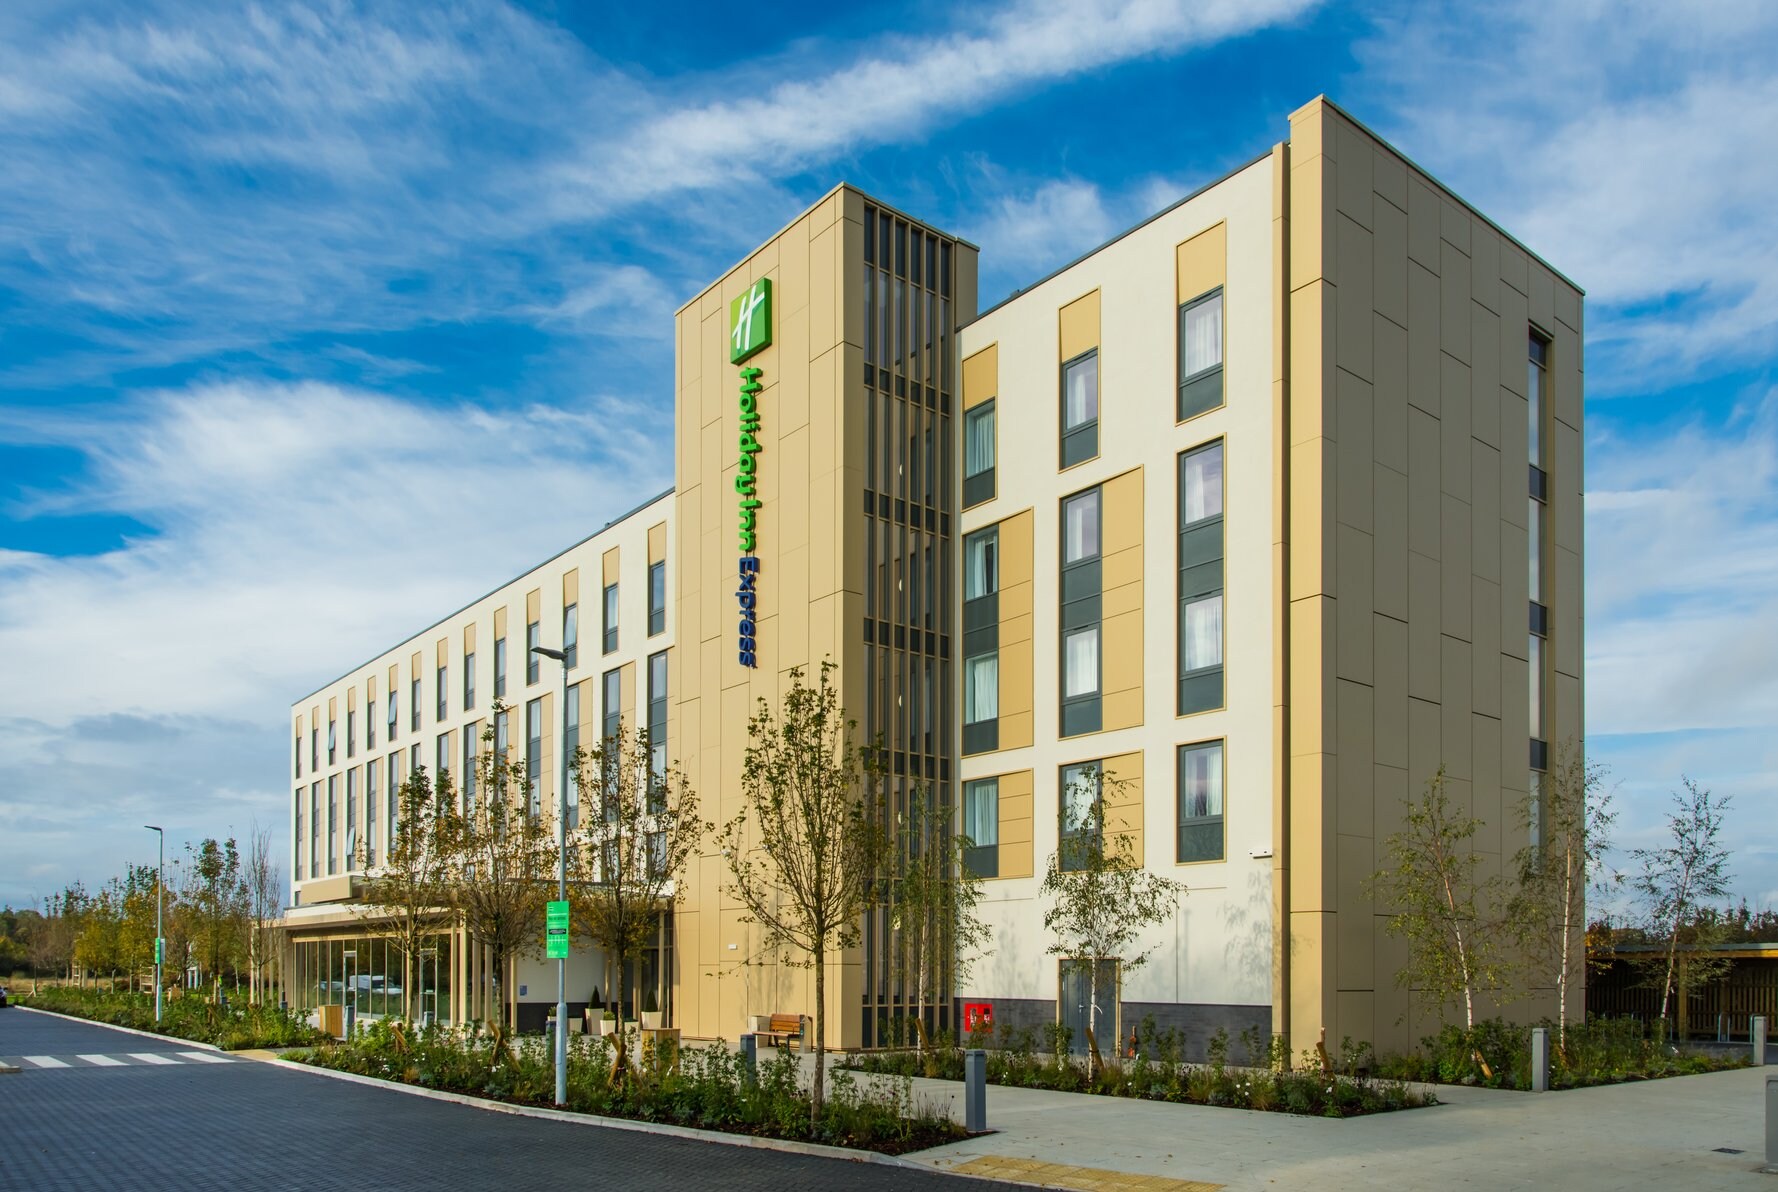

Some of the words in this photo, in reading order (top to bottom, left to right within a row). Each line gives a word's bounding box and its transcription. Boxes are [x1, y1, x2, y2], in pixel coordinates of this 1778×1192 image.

[732, 285, 765, 351] H
[735, 367, 762, 494] Holiday
[739, 500, 762, 552] Inn
[735, 557, 760, 667] Express
